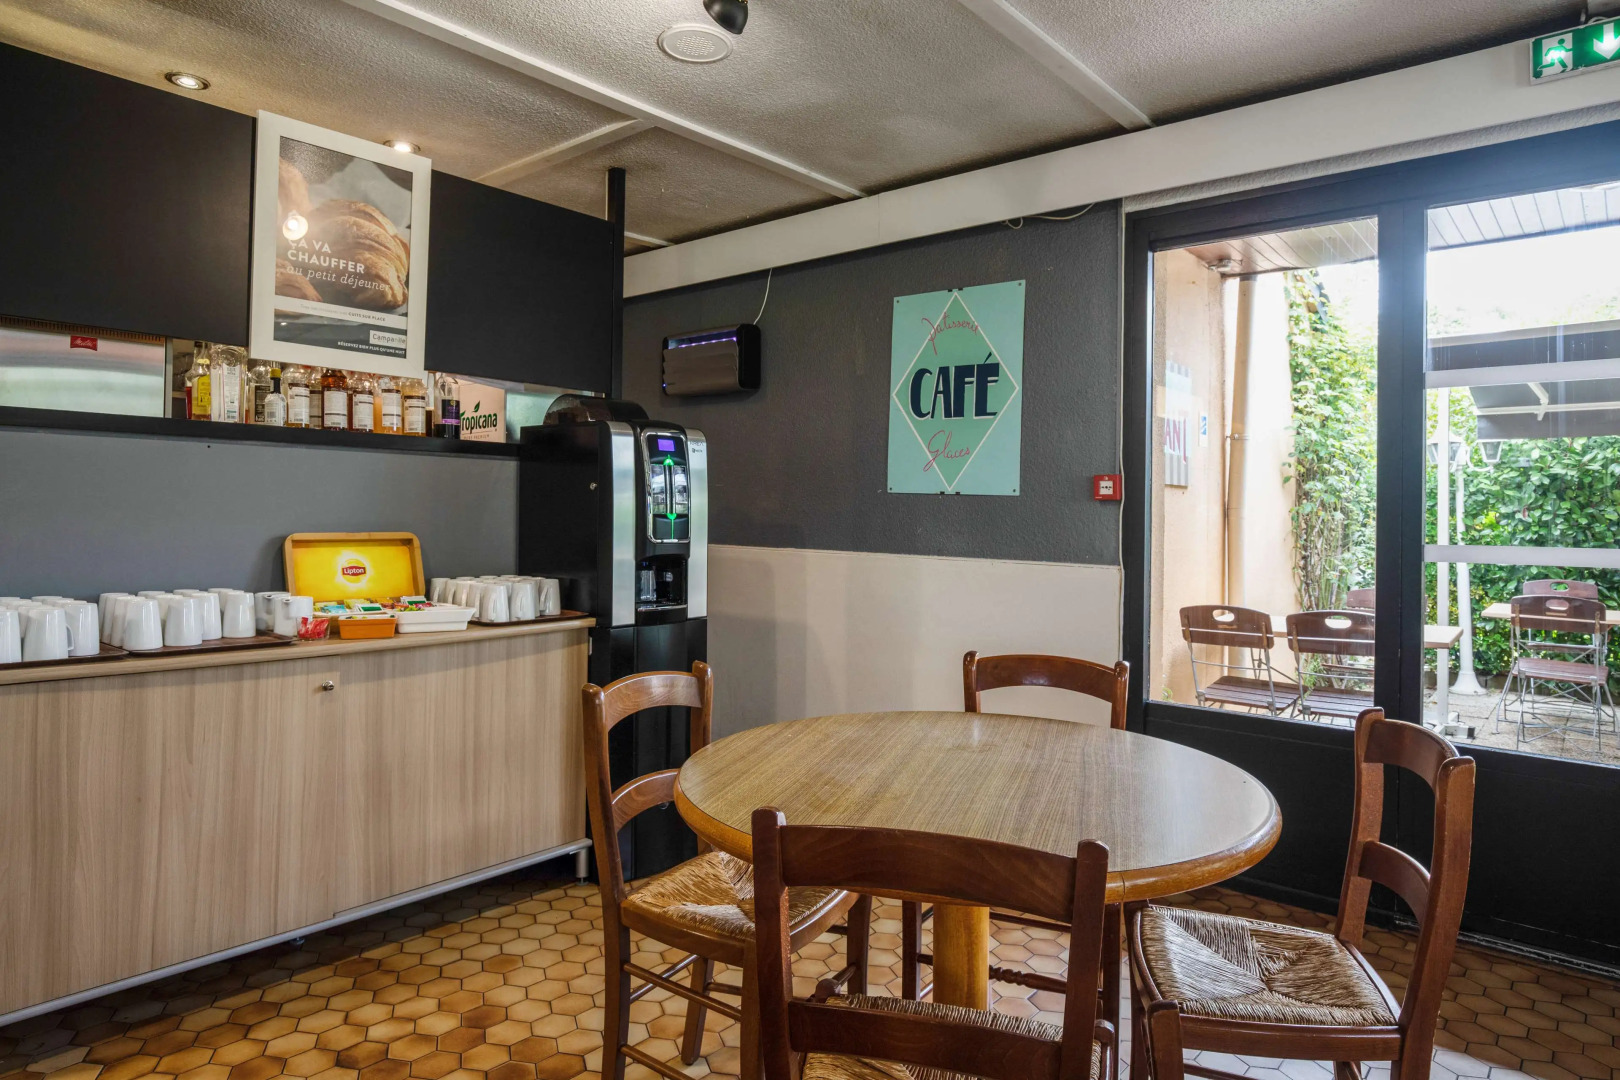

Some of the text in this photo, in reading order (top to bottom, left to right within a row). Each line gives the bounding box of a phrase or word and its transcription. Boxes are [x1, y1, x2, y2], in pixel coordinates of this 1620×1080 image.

[312, 239, 331, 253] VA
[287, 249, 365, 274] CHAUFFER
[286, 265, 391, 291] au petit déjeuner
[909, 351, 1000, 420] CAFÉ
[922, 429, 971, 473] Glaces
[343, 567, 365, 575] Lipton
